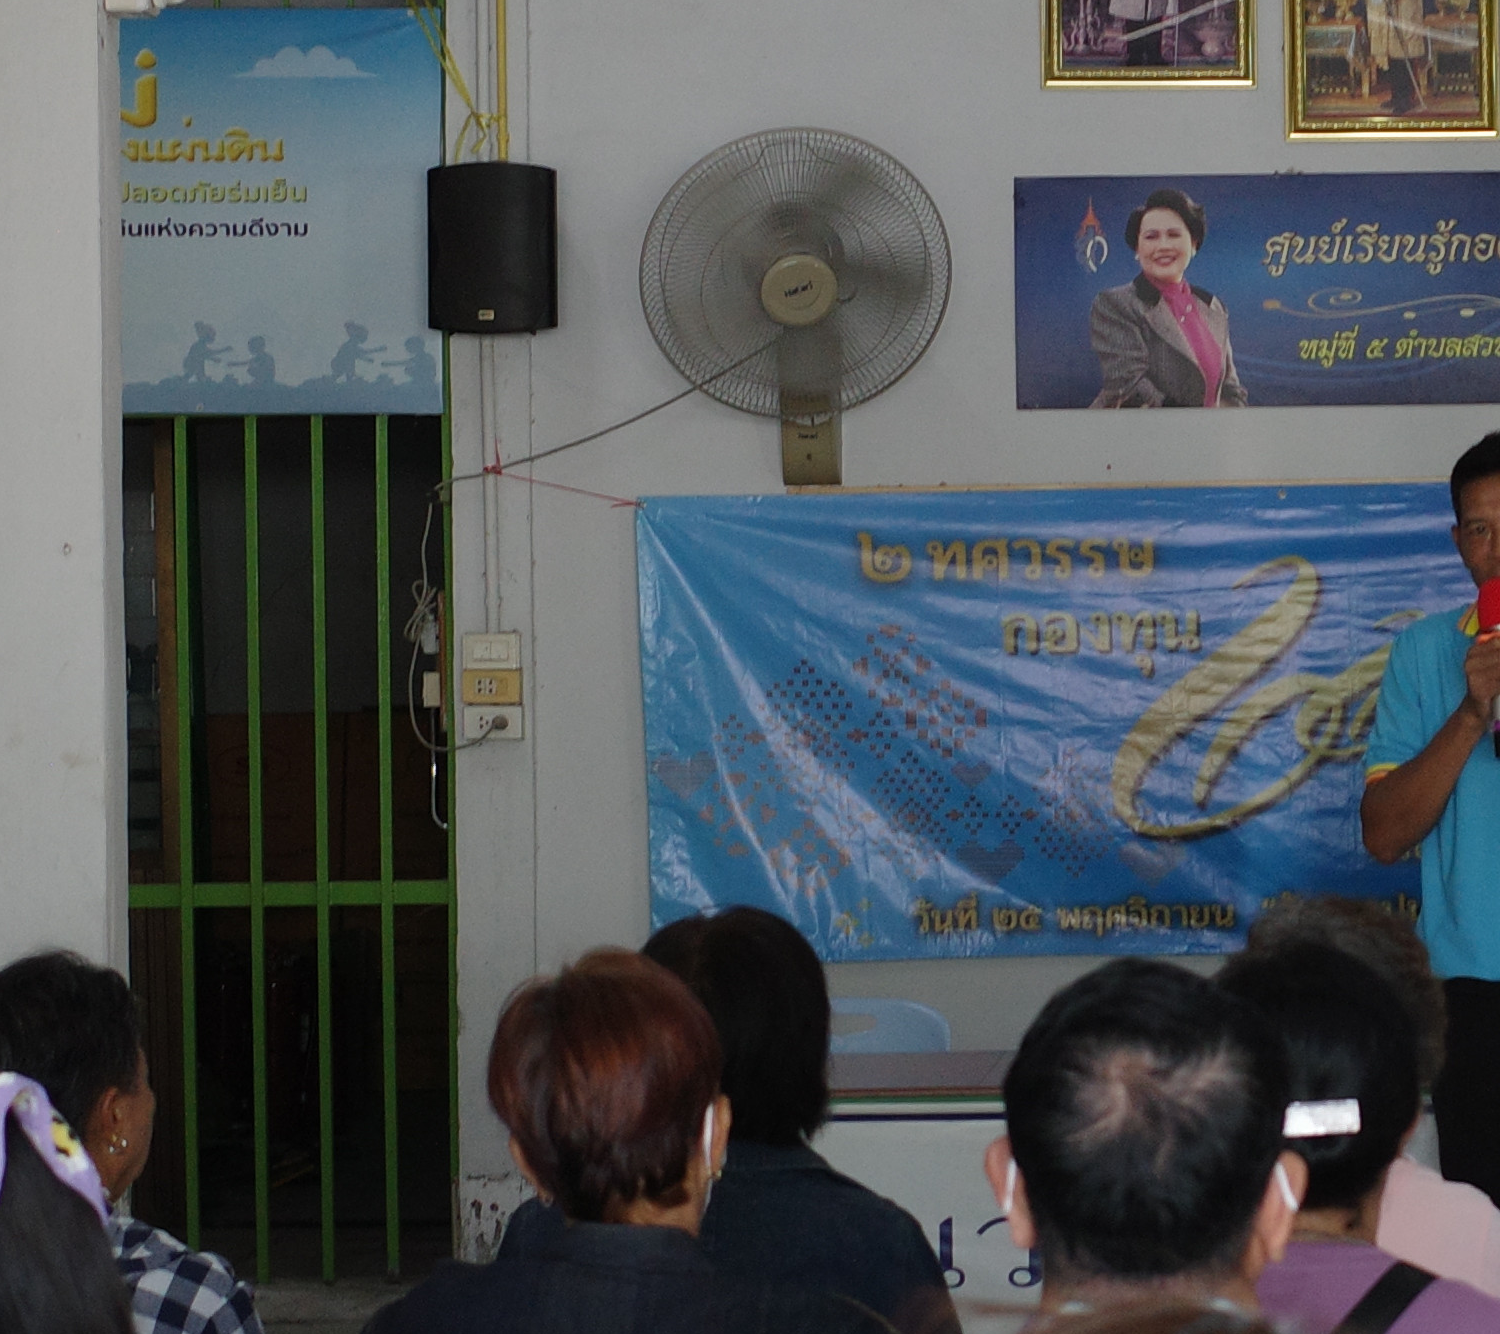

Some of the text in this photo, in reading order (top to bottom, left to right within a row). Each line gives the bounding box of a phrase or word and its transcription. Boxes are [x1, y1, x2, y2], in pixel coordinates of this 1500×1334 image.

[1298, 324, 1360, 368] หมู่ที่
[857, 532, 1157, 585] ๒ ทศวรรษ
[1002, 601, 1203, 678] กองทุน
[913, 890, 979, 936] วันที่
[1057, 896, 1237, 941] พฤศจิกายน
